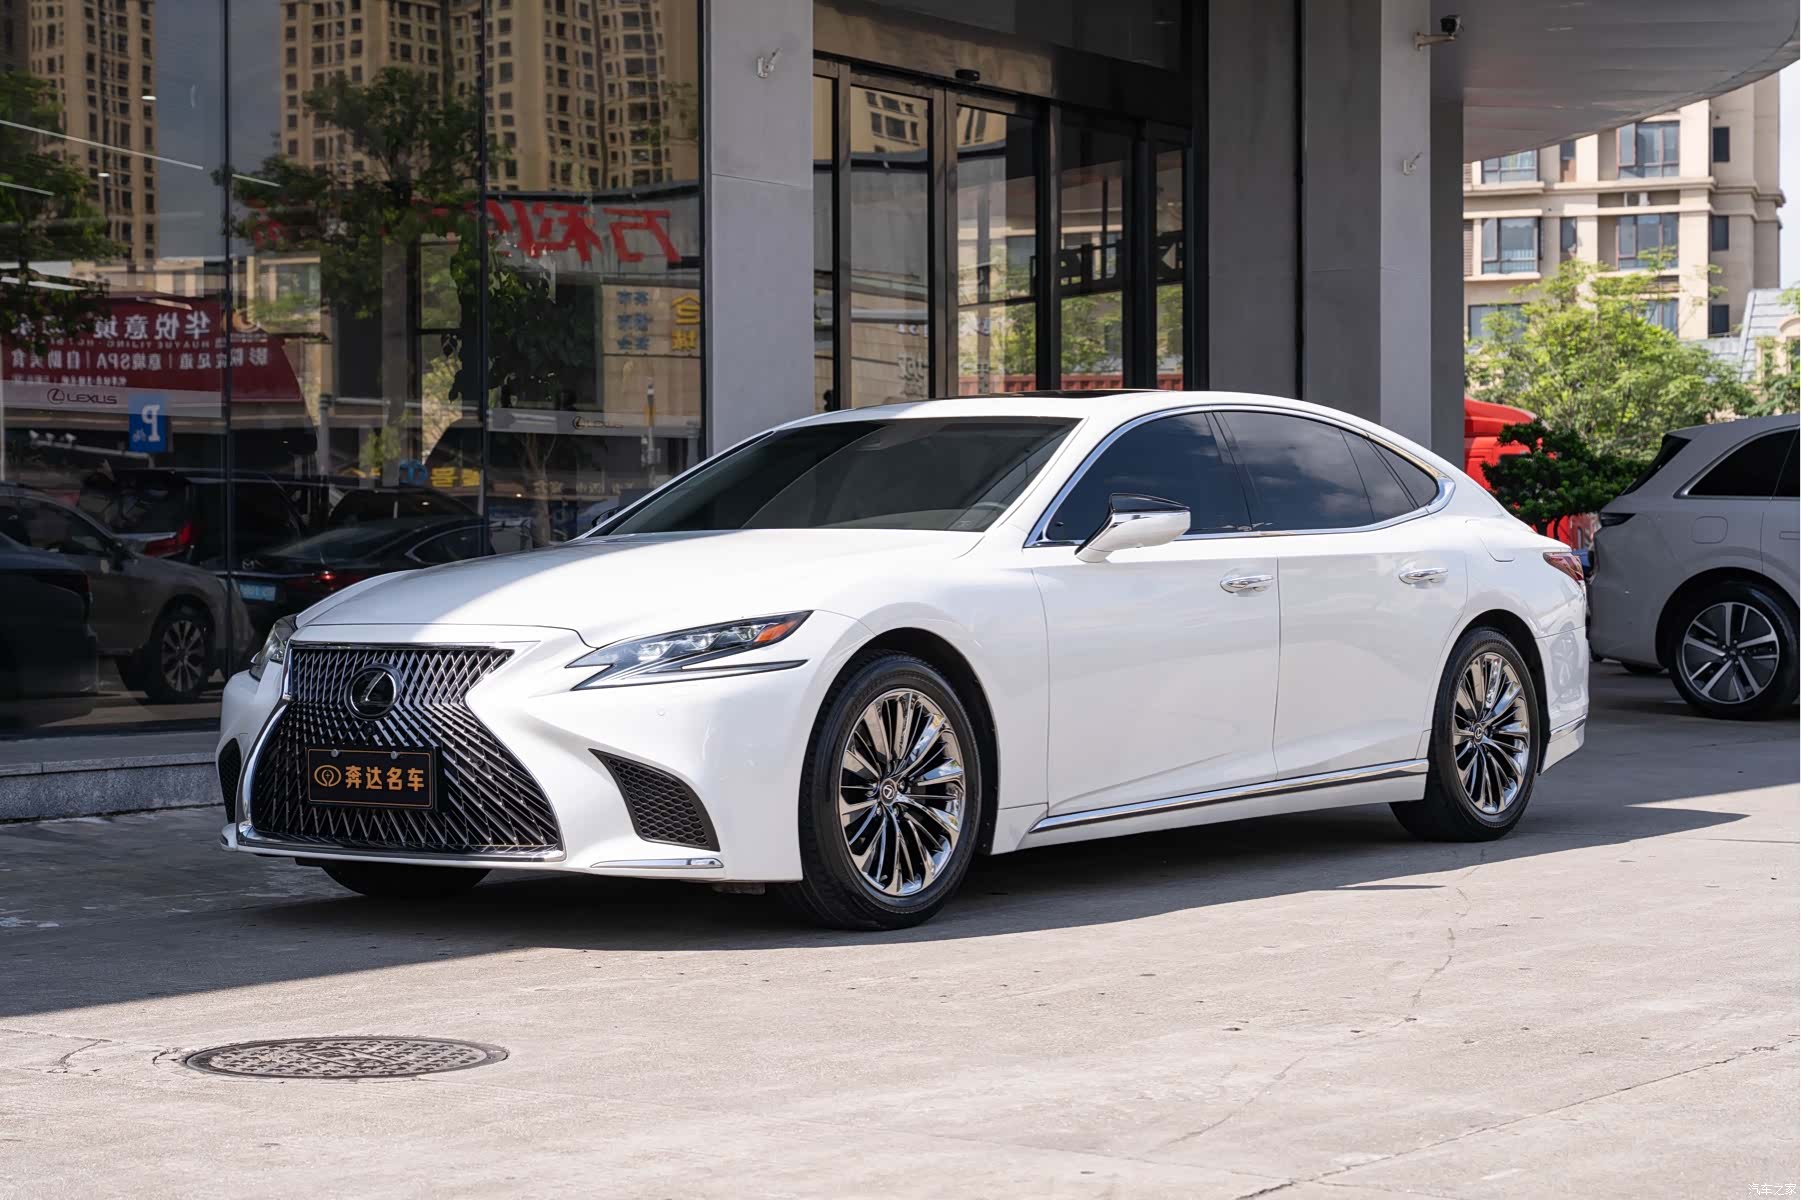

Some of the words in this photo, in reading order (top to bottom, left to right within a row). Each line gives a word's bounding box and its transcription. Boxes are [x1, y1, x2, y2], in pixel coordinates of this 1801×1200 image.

[66, 393, 117, 405] LEXUS
[345, 765, 425, 792] 奔达名车
